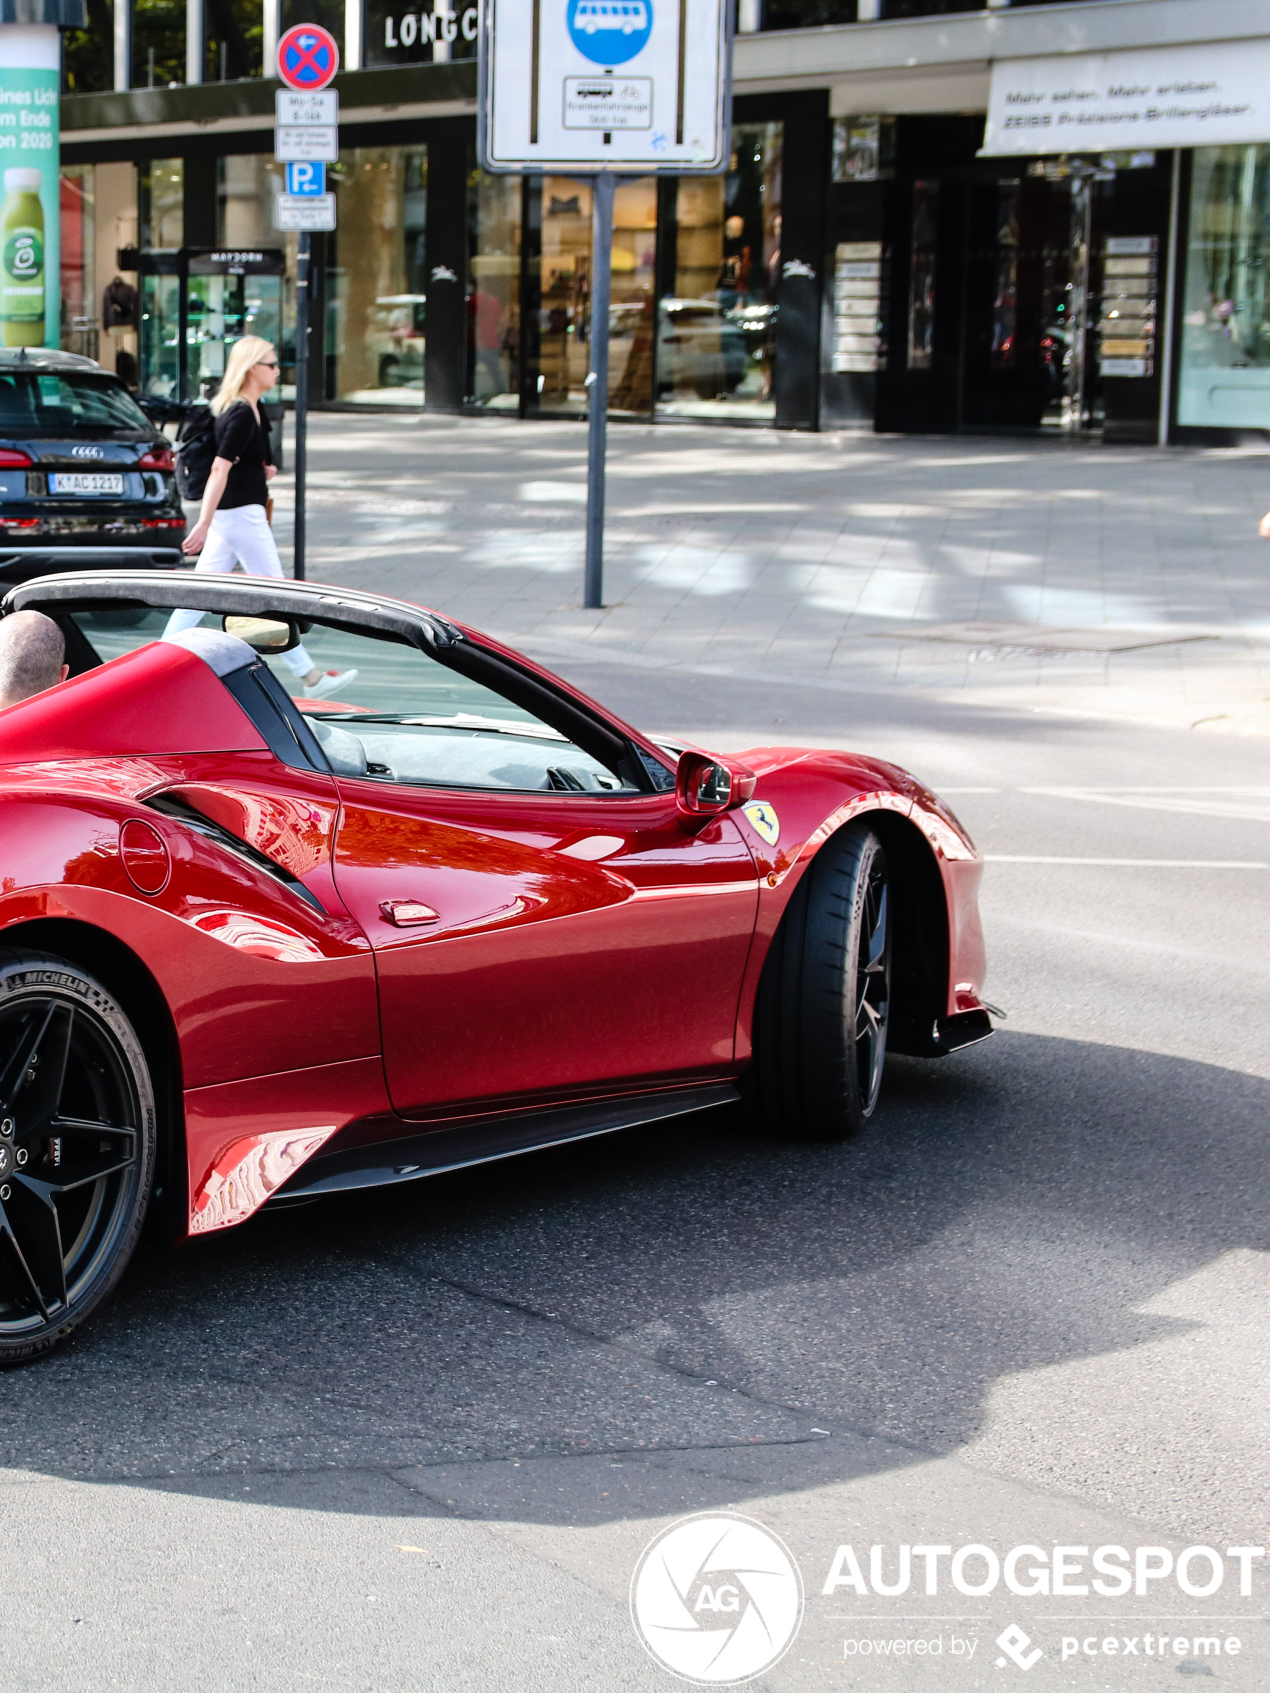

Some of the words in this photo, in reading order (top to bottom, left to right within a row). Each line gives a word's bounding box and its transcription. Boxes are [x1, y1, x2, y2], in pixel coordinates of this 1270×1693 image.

[1006, 90, 1046, 104] Mehr
[1108, 83, 1151, 98] Mehr
[19, 109, 52, 128] Ende
[20, 131, 54, 149] 2020
[292, 163, 314, 193] P
[58, 476, 66, 489] K
[24, 971, 91, 994] MICHELIN
